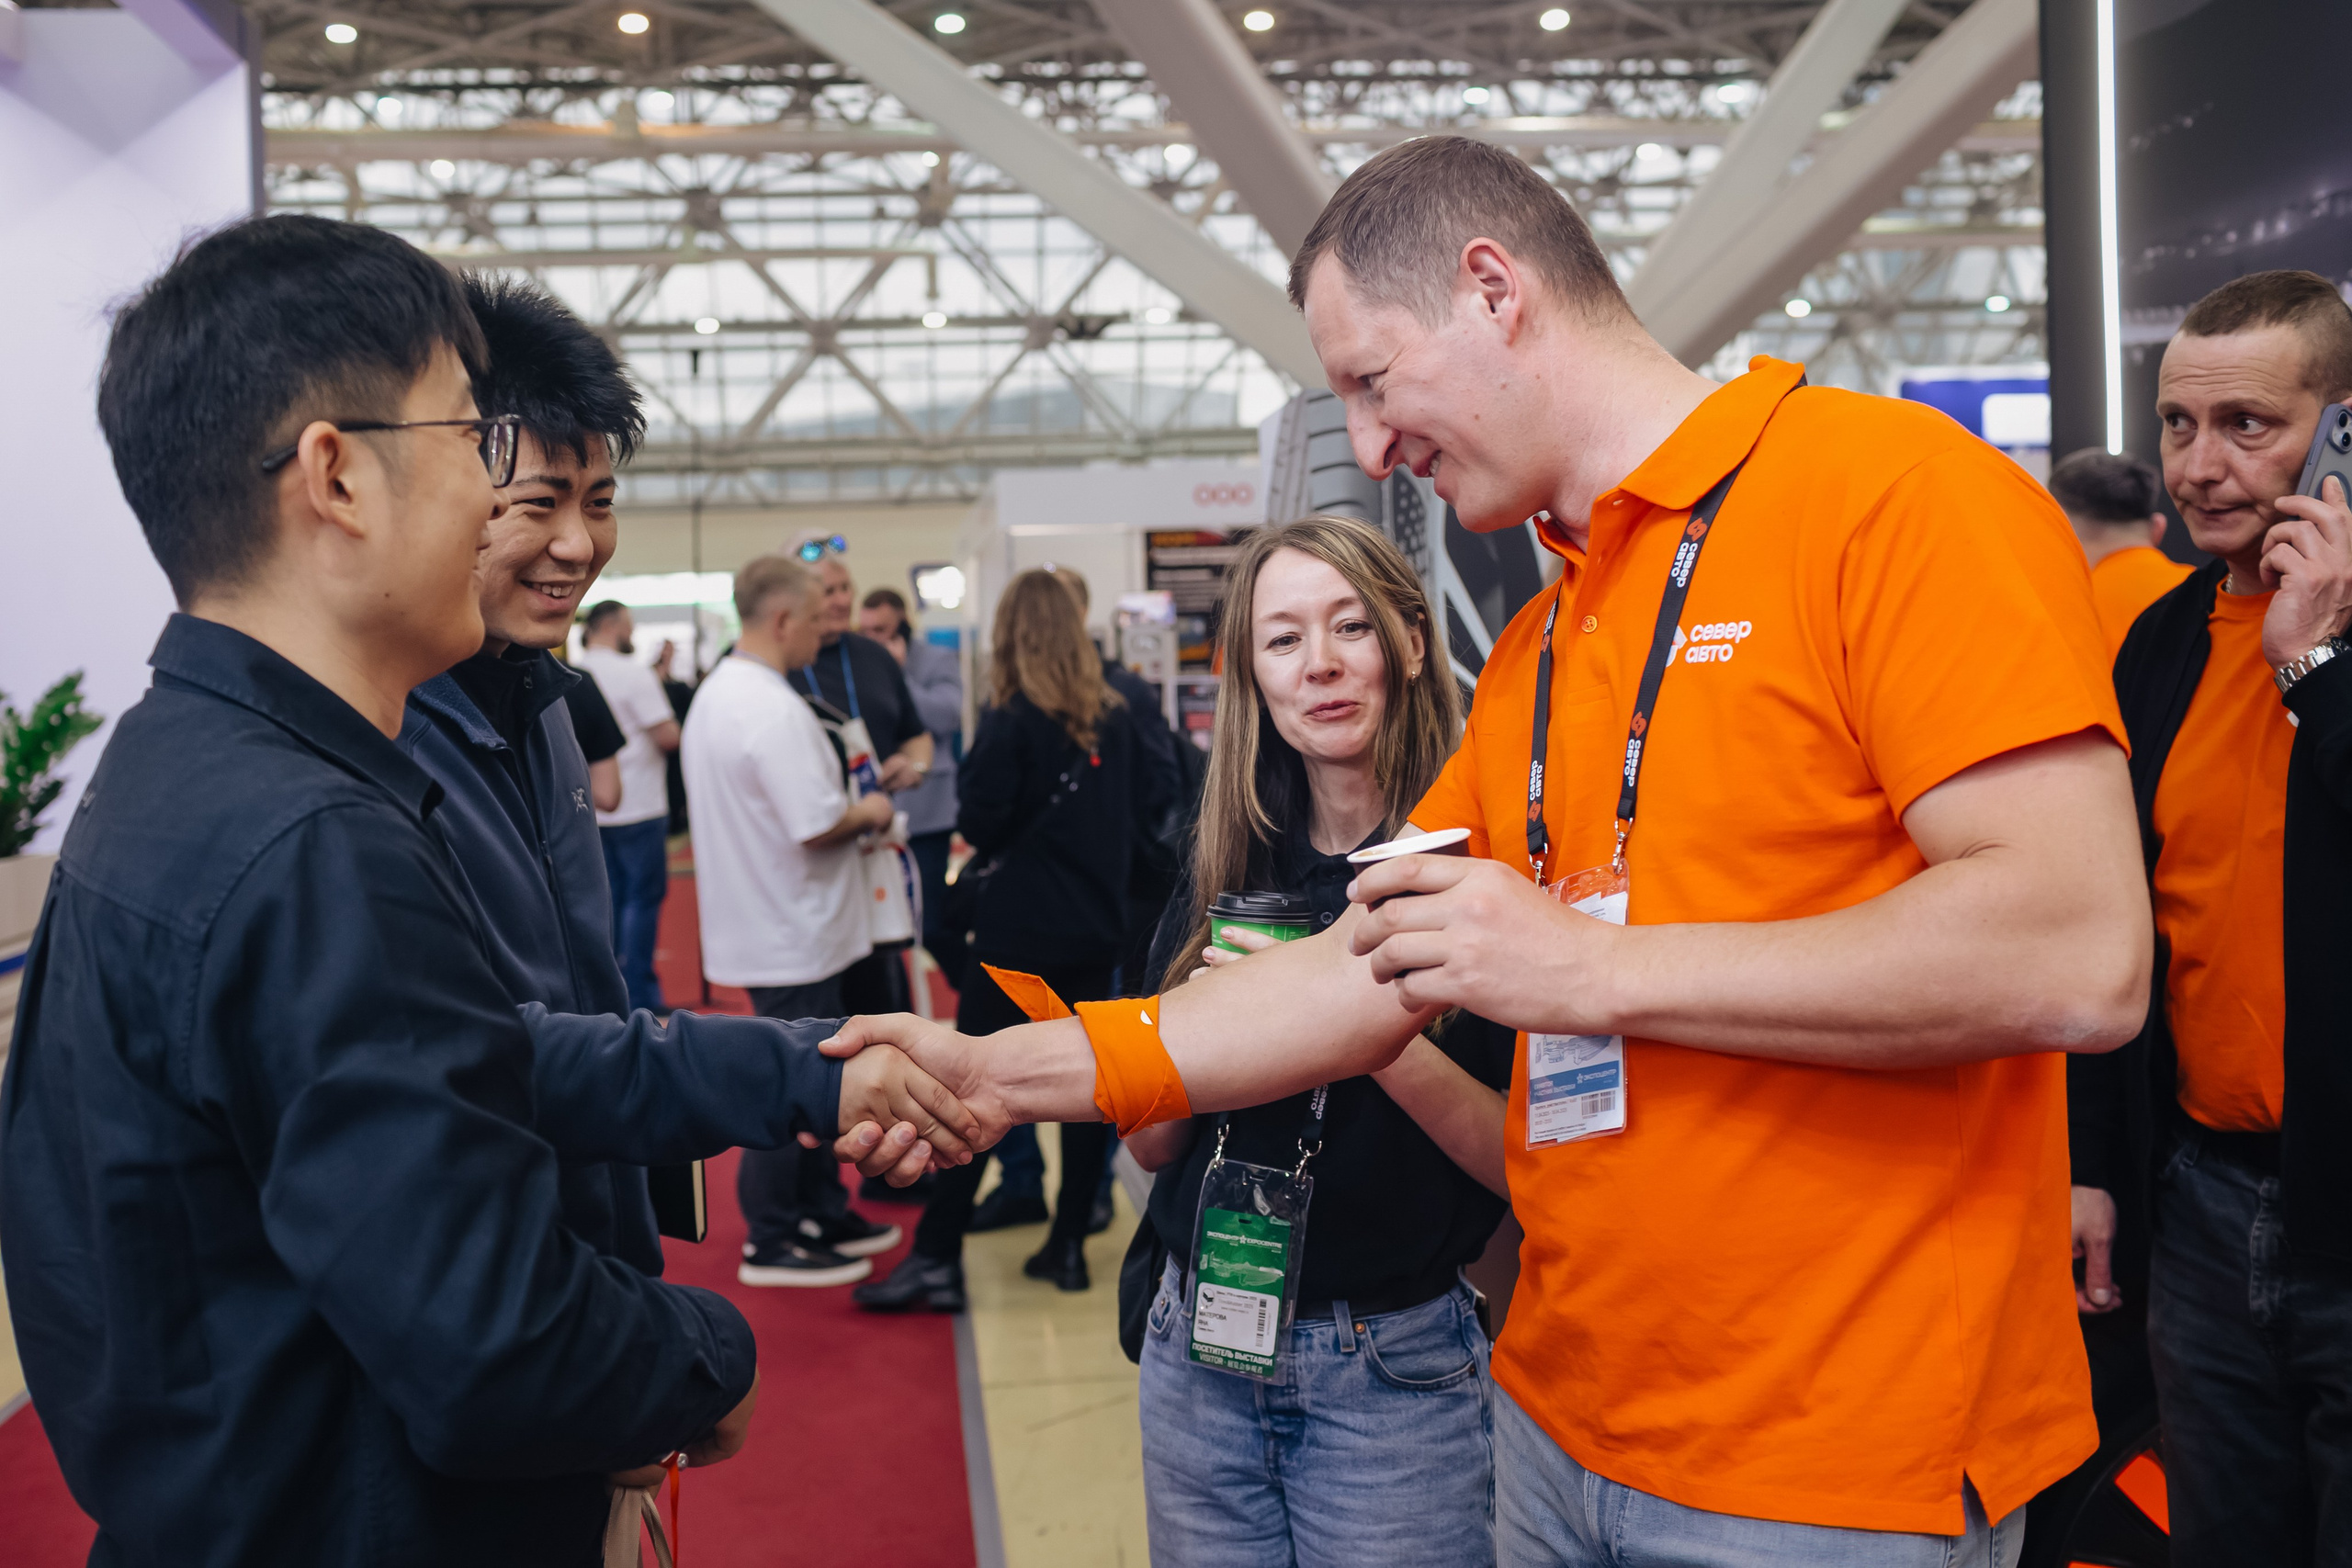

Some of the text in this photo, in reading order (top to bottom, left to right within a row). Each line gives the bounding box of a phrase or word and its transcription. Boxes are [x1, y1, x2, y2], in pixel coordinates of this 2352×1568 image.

[1670, 542, 1689, 578] авто
[1677, 542, 1698, 588] север
[1690, 620, 1753, 644] север
[1685, 643, 1734, 664] авто
[1623, 739, 1635, 776] авто
[1627, 739, 1642, 787] север
[1529, 760, 1539, 801] север
[1192, 1342, 1273, 1367] ПОСЕТИТЕЛЬ ВЫСТАВКИ
[1198, 1352, 1224, 1366] VISITOR
